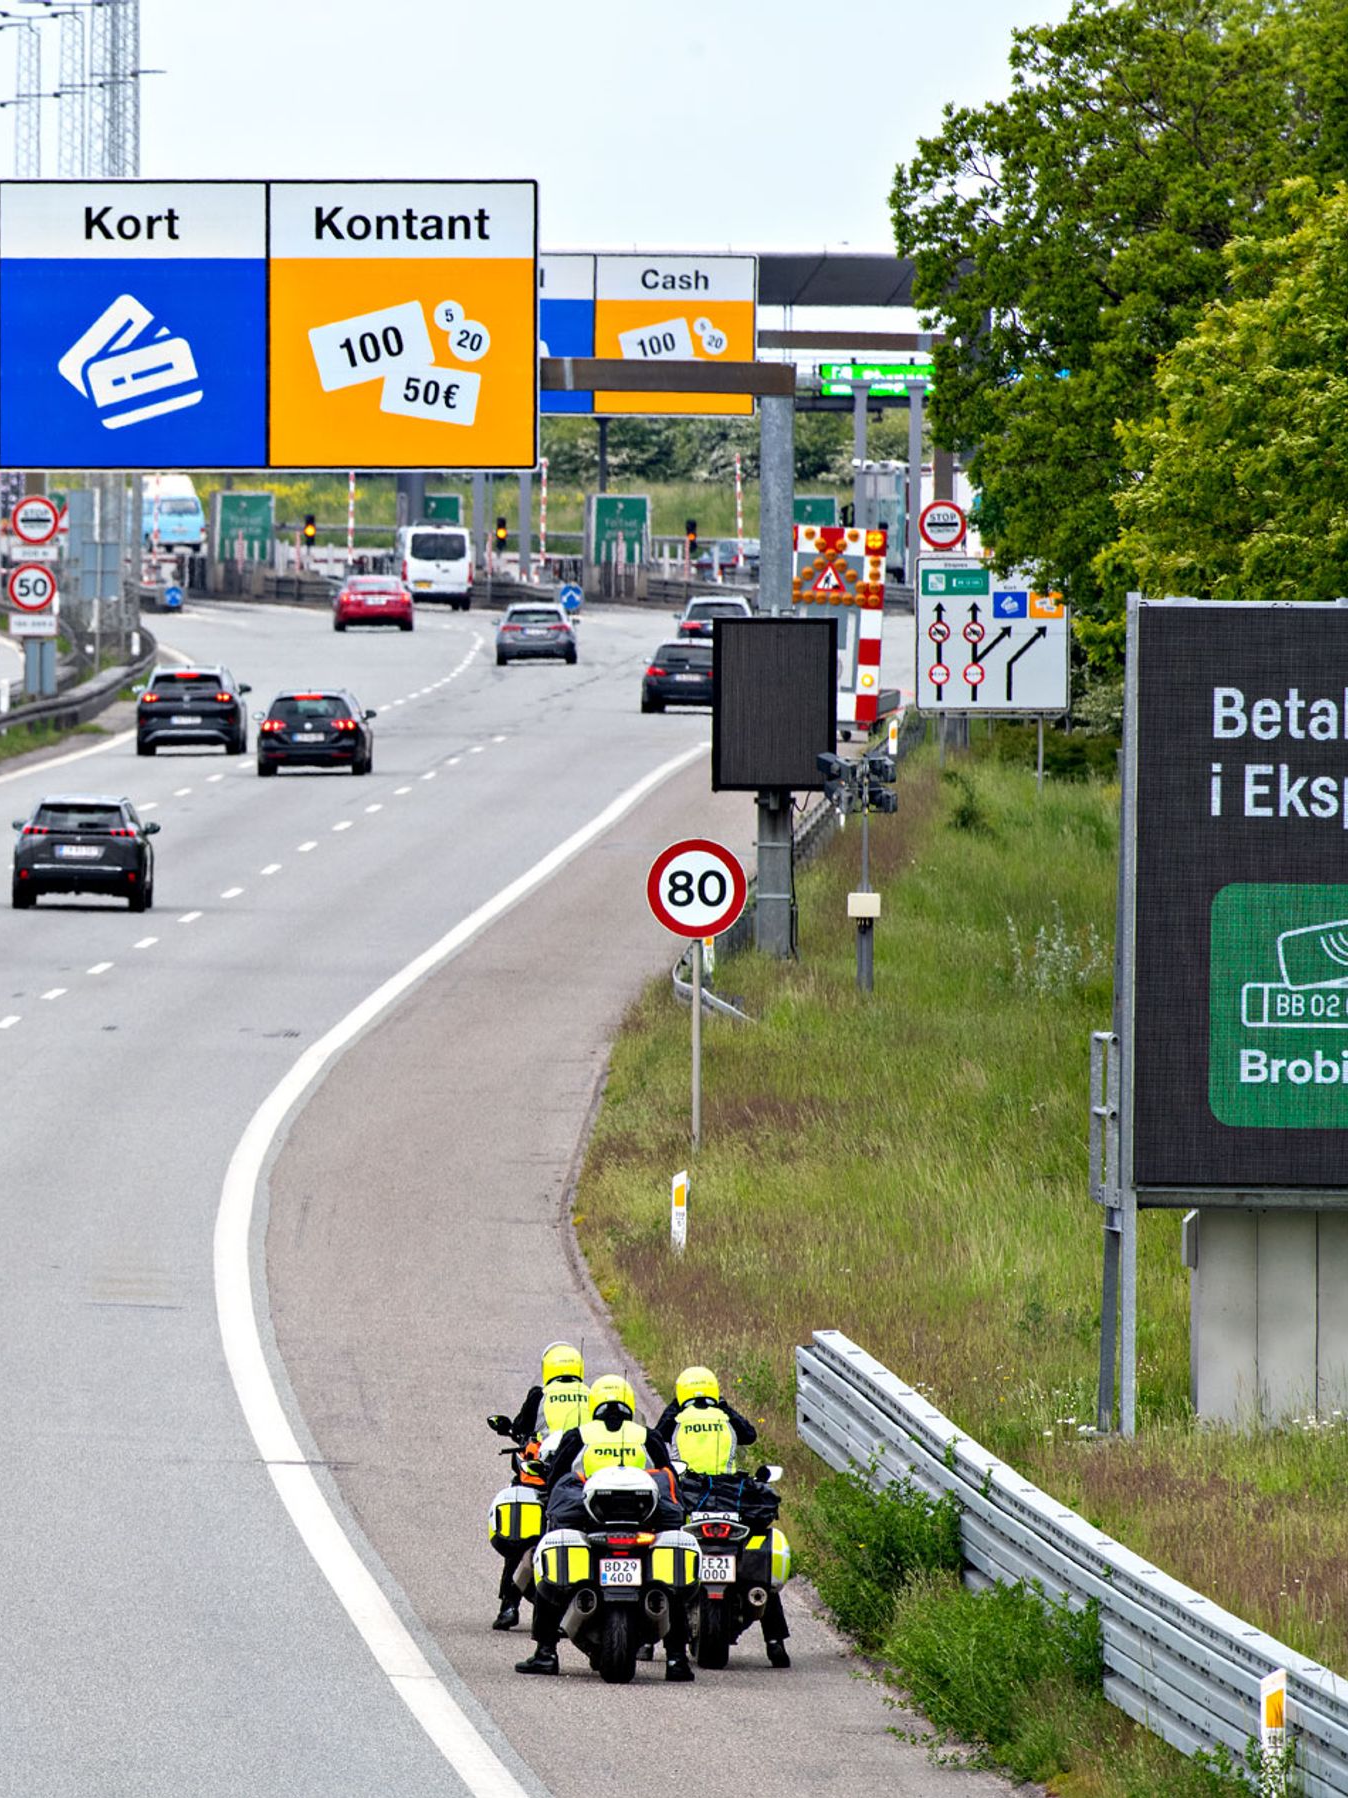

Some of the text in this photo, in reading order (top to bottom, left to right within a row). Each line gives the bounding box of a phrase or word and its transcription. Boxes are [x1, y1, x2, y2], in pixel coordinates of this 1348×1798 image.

[84, 206, 179, 240] Kort
[314, 206, 490, 240] Kontant
[641, 268, 709, 290] Cash
[444, 308, 454, 322] 5
[339, 325, 404, 367] 100
[456, 326, 484, 353] 20
[637, 332, 676, 357] 100
[707, 334, 724, 349] 20
[402, 376, 460, 409] 50€
[929, 513, 957, 523] STOP
[18, 578, 47, 597] 50
[1211, 763, 1221, 816] i
[668, 870, 727, 907] 80
[1277, 993, 1340, 1017] BB 02
[1240, 1048, 1348, 1085] Brobi
[549, 1394, 589, 1404] POLITI
[684, 1423, 724, 1434] POLITI
[610, 1573, 633, 1583] 400
